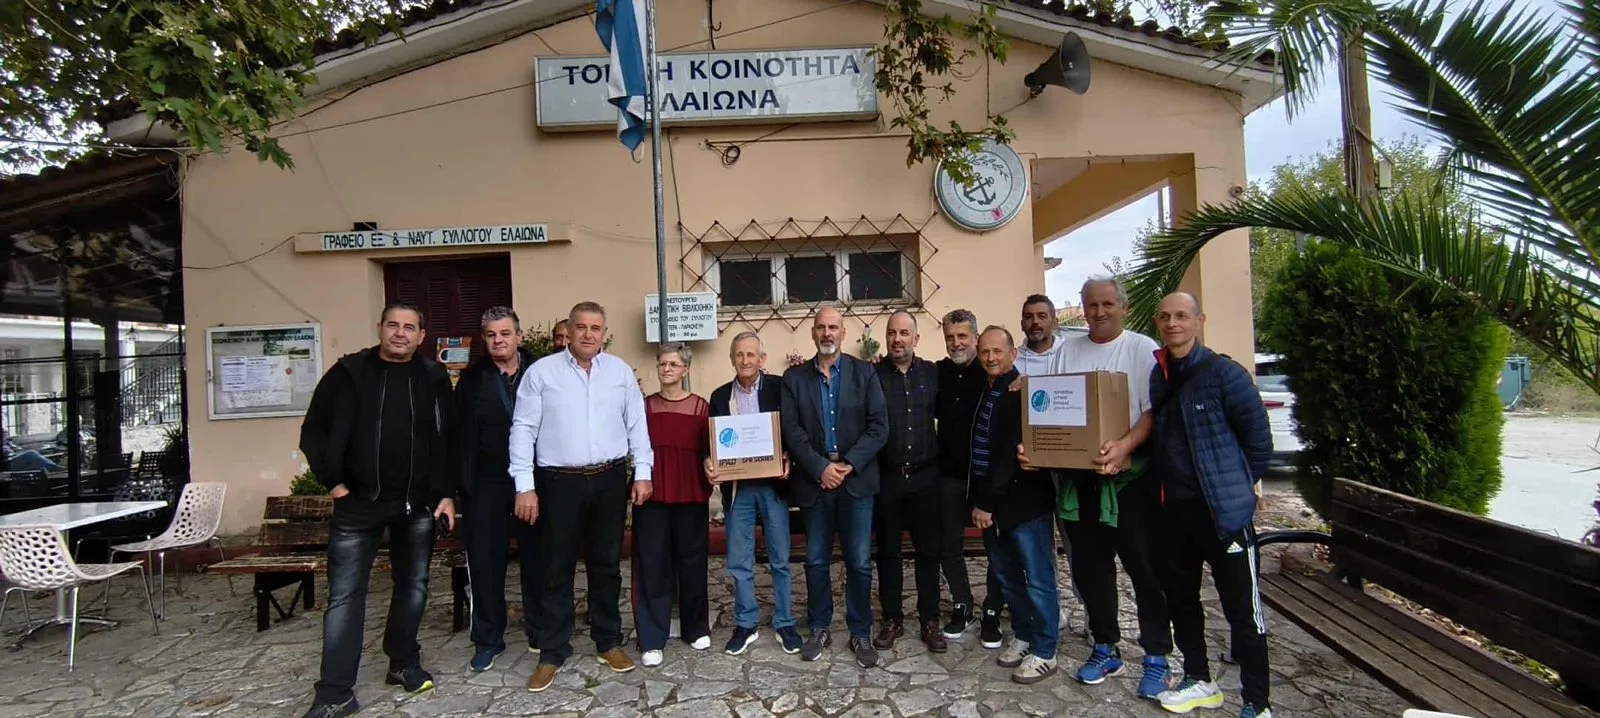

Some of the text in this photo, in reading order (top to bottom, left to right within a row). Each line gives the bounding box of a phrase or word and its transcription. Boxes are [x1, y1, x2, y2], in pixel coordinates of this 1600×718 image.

[690, 54, 860, 80] ΚΟΙΝΟΤΗΤΑ
[323, 233, 364, 249] ΓΡΑΦΕΙΟ
[392, 232, 399, 246] &
[408, 231, 436, 246] ΝΑΥΤ.
[442, 228, 492, 244] ΣΥΛΛΟΓΟΥ
[501, 226, 545, 242] ΕΛΑΙΩΝΑ
